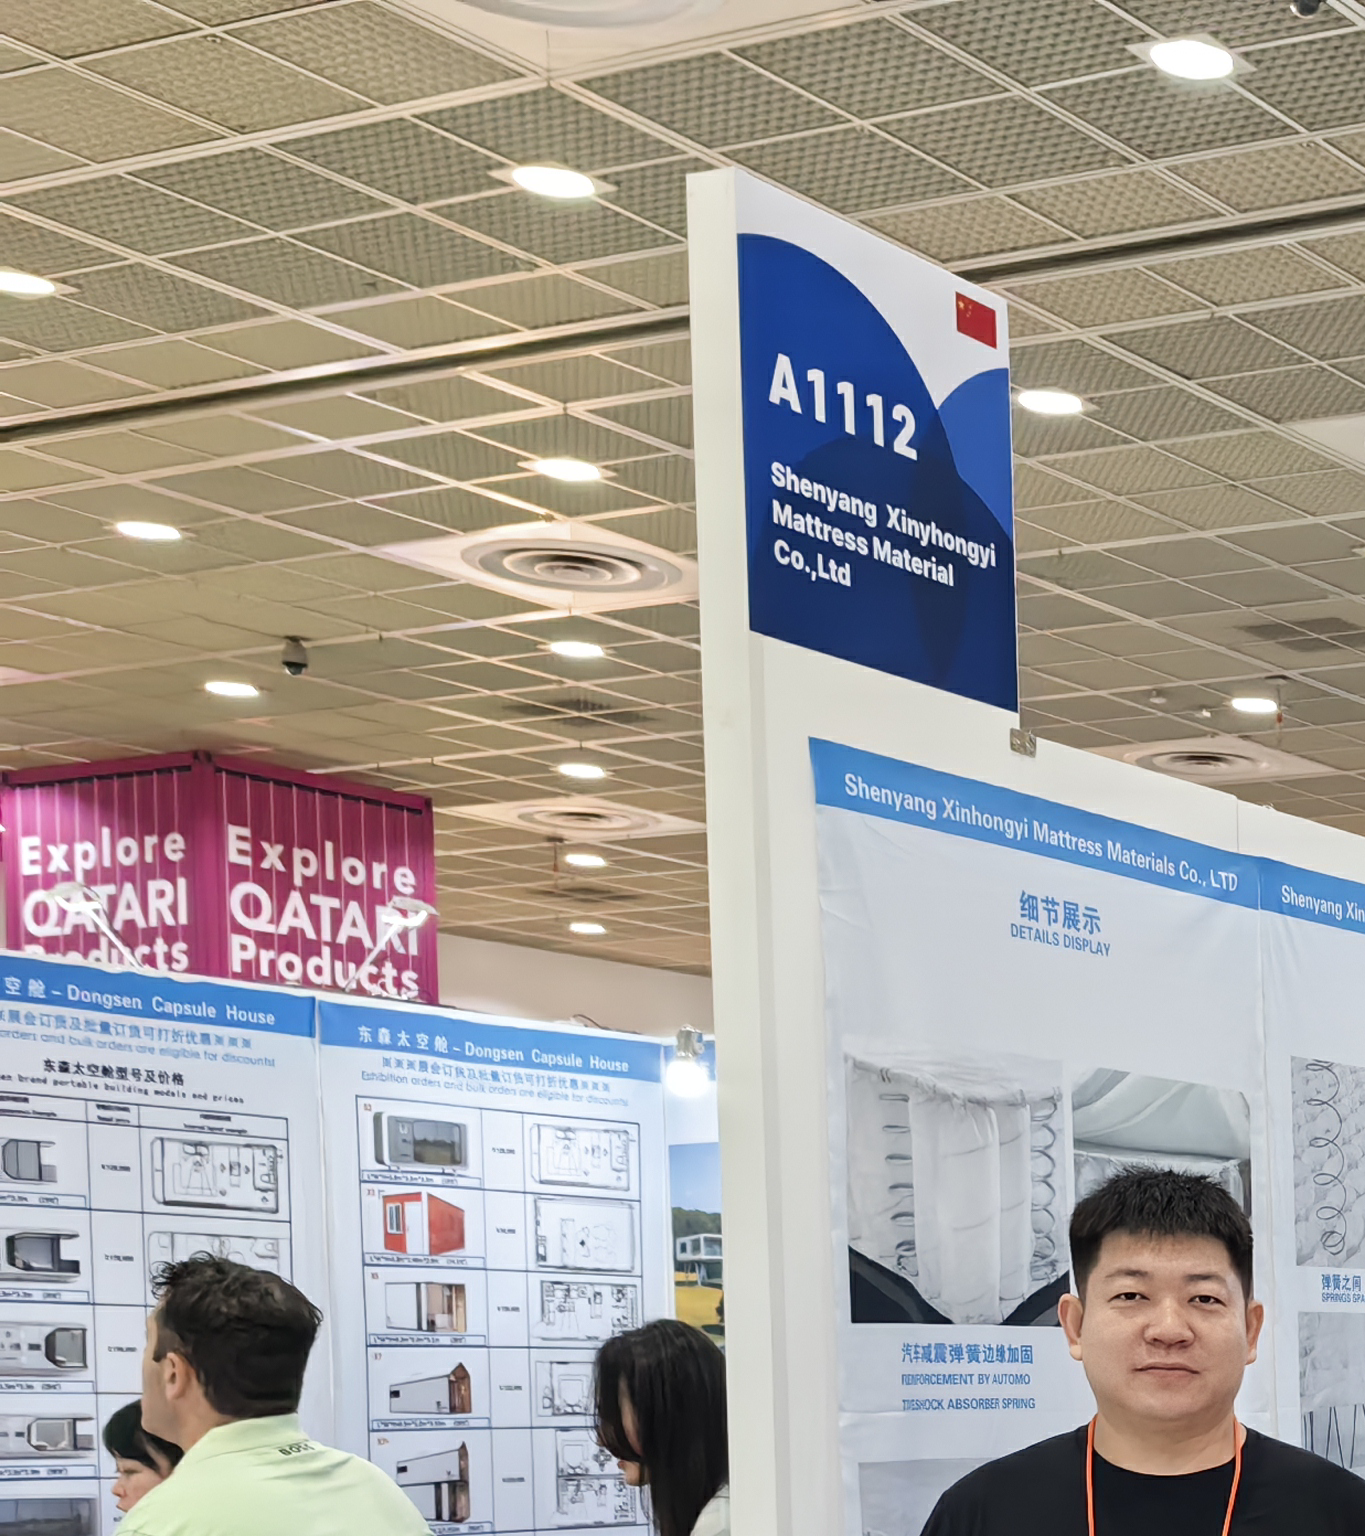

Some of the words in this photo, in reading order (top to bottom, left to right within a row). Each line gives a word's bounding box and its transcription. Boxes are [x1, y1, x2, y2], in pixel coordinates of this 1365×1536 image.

[769, 353, 917, 461] A1112
[772, 462, 877, 528] Shenyang
[886, 503, 996, 569] Xinyhongyi
[772, 499, 868, 556] Mattress
[873, 537, 954, 587] Material
[774, 540, 851, 588] Co.,Ltd
[21, 826, 186, 880] Explore
[844, 772, 937, 820] Shenyang
[942, 797, 1029, 840] Xinhongyi
[1033, 820, 1102, 857] Mattress
[1107, 840, 1175, 877] Materials
[1210, 869, 1238, 892] LTD
[227, 823, 415, 895] Explore
[23, 877, 188, 937] QATARI
[229, 882, 418, 956] QATARI
[1019, 890, 1101, 935] 细节展示
[1281, 885, 1342, 921] Shenyang
[1010, 922, 1059, 948] DETAILS
[1063, 934, 1110, 957] DISPLAY
[67, 985, 142, 1011] Dongsen
[152, 996, 216, 1018] Capsule
[226, 1005, 275, 1025] House
[464, 1042, 524, 1063] Dongsen
[531, 1048, 583, 1069] Capsule
[590, 1055, 629, 1073] House
[902, 1343, 1033, 1364] 汽车减震弹簧边缘加固
[978, 1374, 990, 1385] BY
[992, 1374, 1031, 1385] AUTOMO
[947, 1398, 1000, 1410] ABSORBER
[1002, 1398, 1036, 1409] SPRING
